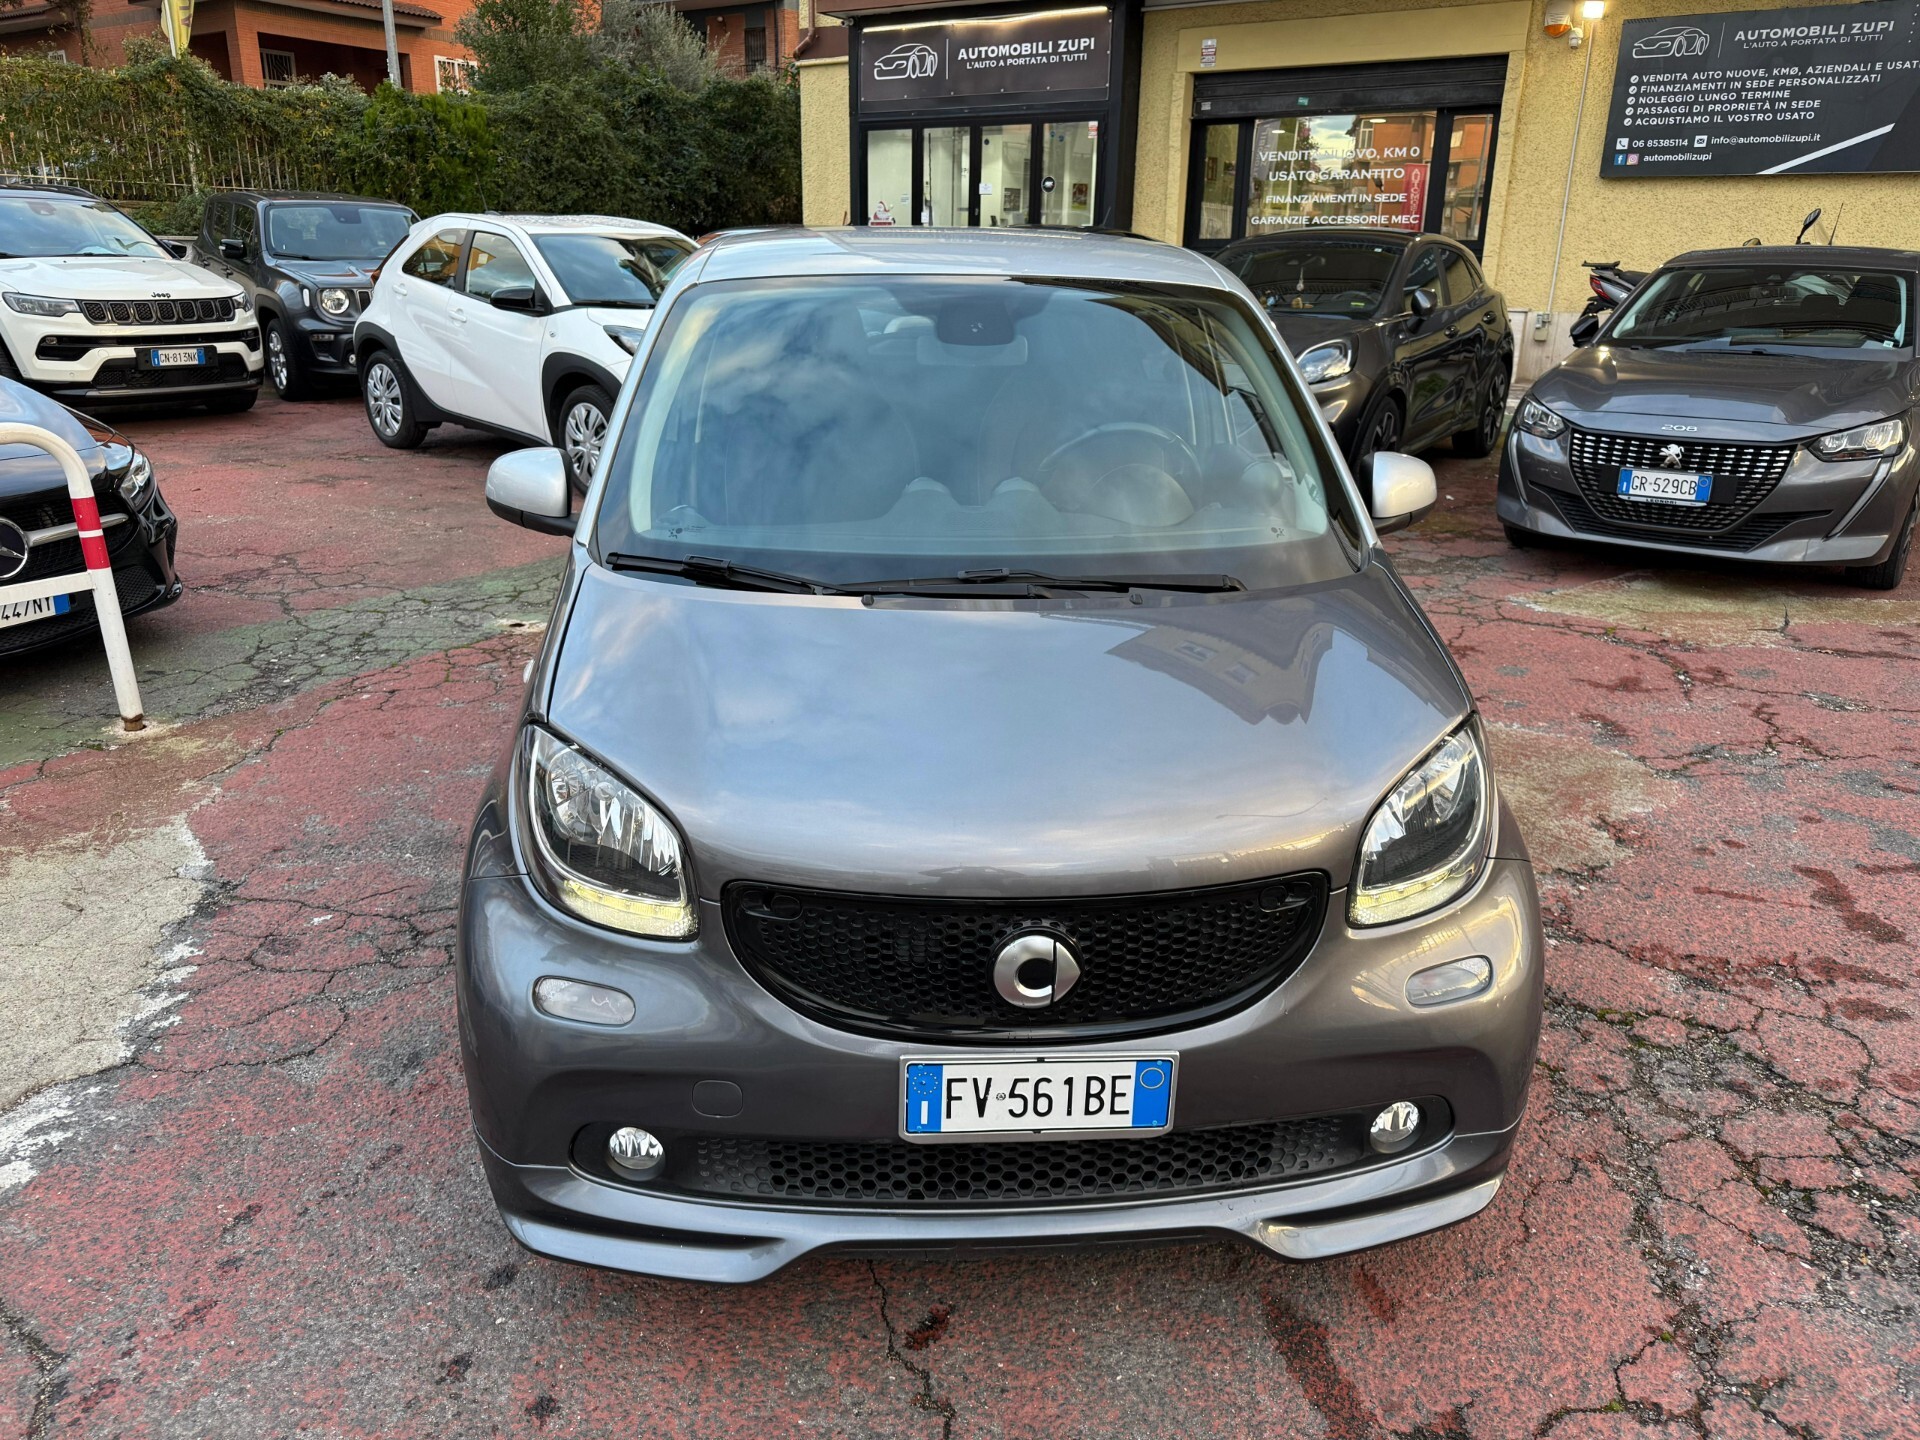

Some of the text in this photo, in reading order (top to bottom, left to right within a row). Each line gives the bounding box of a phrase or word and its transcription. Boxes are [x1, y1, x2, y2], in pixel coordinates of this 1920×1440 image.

[1734, 21, 1894, 41] AUTOMOBILI ZUPI
[957, 37, 1095, 60] AUTOMOBILI ZUPI
[1744, 41, 1778, 49] L'AUTO
[1791, 38, 1837, 46] PORTATA
[1854, 34, 1883, 42] TUTTI
[966, 60, 997, 70] L'AUTO
[1007, 56, 1047, 66] PORTATA
[1050, 55, 1060, 63] DI
[1061, 53, 1088, 62] TUTTI
[1642, 73, 1688, 82] VENDITA
[1692, 70, 1722, 80] AUTO
[1726, 68, 1768, 78] NUOVE,
[1806, 63, 1871, 74] AZIENDALI
[1875, 62, 1883, 71] E
[1887, 60, 1920, 70] USAT
[1640, 74, 1881, 93] FINANZIAMENTI IN SEDE PERSONALIZZATI
[1638, 90, 1791, 104] NOLEGGIO LUNGO TERMINE
[1637, 100, 1821, 115] PASSAGGI DI PROPRIETÀ IN SEDE
[1635, 111, 1815, 126] ACQUISTIAMO IL VOSTRO USATO
[1632, 140, 1645, 148] 06
[1711, 133, 1821, 145] info@automobilizupi.it
[1259, 150, 1318, 162] VENDITA
[1384, 147, 1406, 158] KM
[1643, 152, 1712, 162] automobilizupi
[1268, 167, 1405, 182] USATO GARANTITO
[1265, 193, 1408, 204] FINANZIAMENTI IN SEDE
[1251, 214, 1420, 225] GARANZIE ACCESSORIE MEC
[1661, 424, 1698, 432] 208
[1653, 477, 1698, 496] 529CB
[945, 1077, 993, 1119] FV
[1007, 1074, 1132, 1118] 561BE
